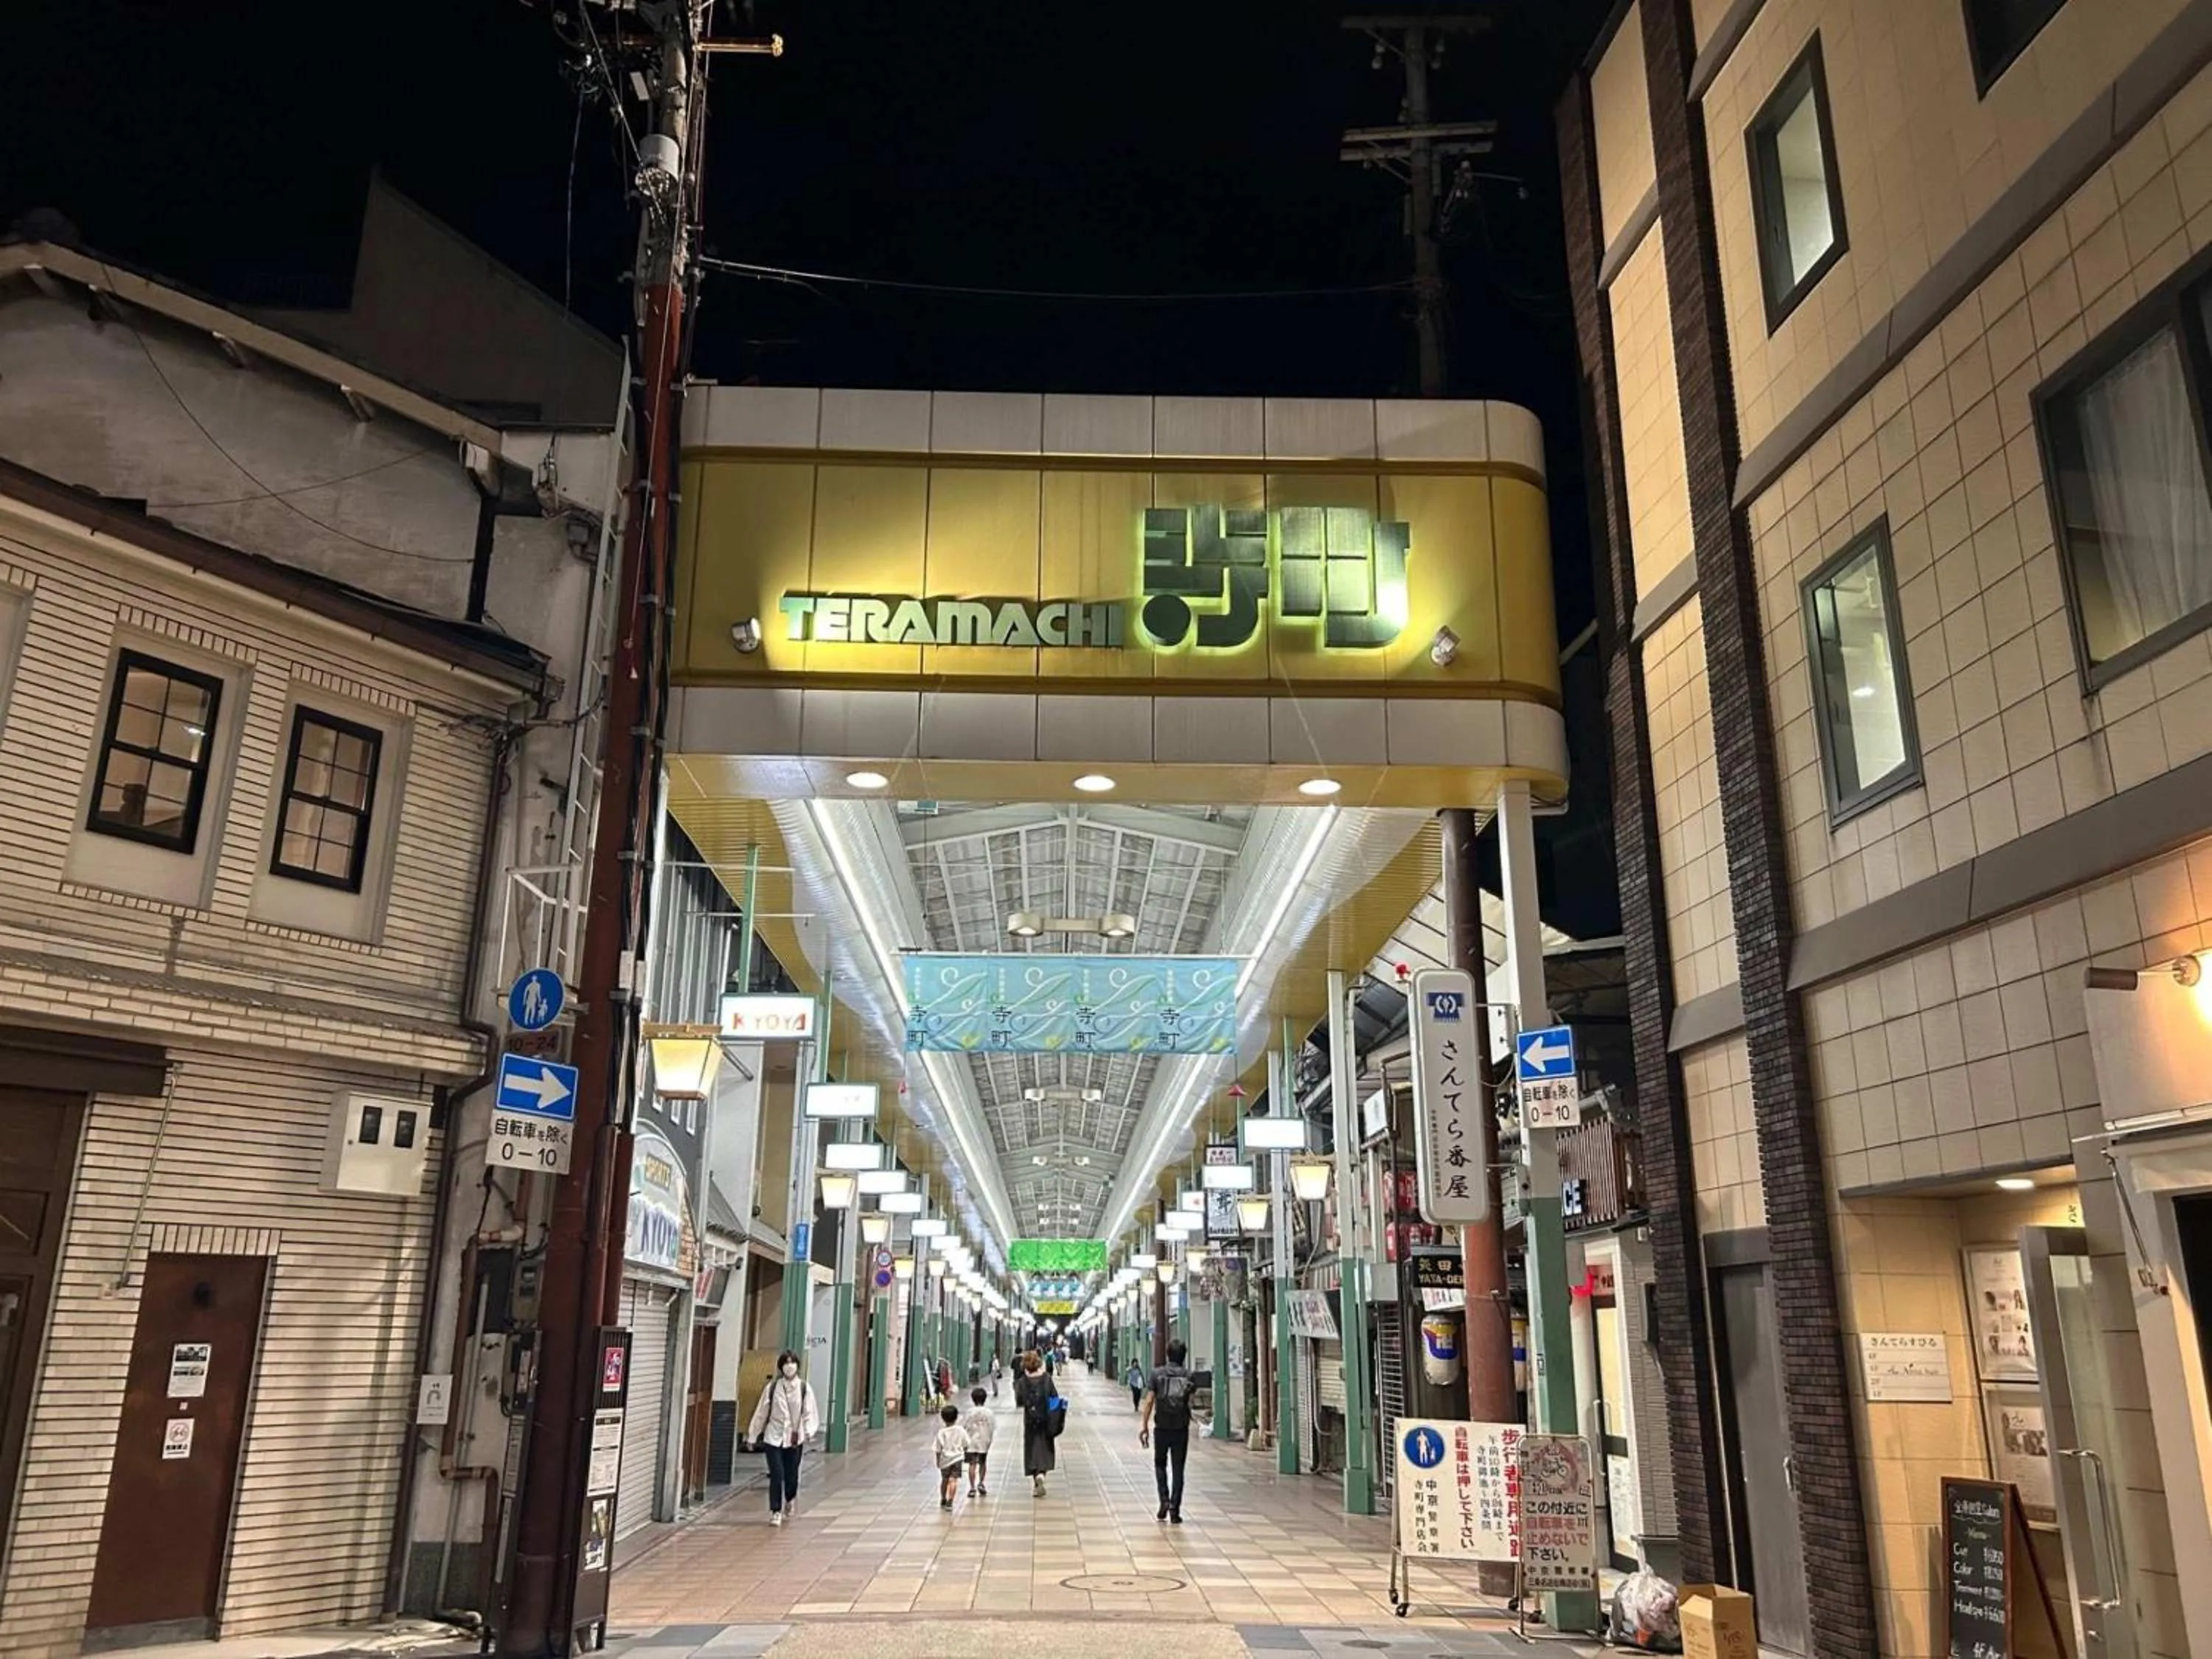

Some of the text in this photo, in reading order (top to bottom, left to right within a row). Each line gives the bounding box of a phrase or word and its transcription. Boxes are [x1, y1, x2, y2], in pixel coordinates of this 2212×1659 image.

[782, 591, 1124, 650] TERAMACHI
[908, 1004, 928, 1047] 寺町
[992, 1006, 1012, 1048] 寺町
[1076, 1006, 1096, 1048] 寺町
[1159, 1007, 1180, 1049] 寺町
[1523, 1083, 1576, 1103] 自転車を除く
[495, 1118, 568, 1145] 自転車を除く
[1440, 1040, 1472, 1200] さんてら番屋
[1455, 1426, 1474, 1549] 自転車は押して下さい
[1526, 1500, 1587, 1515] この付近に
[1526, 1533, 1588, 1546] 止めないで
[1526, 1548, 1569, 1562] 下さい。
